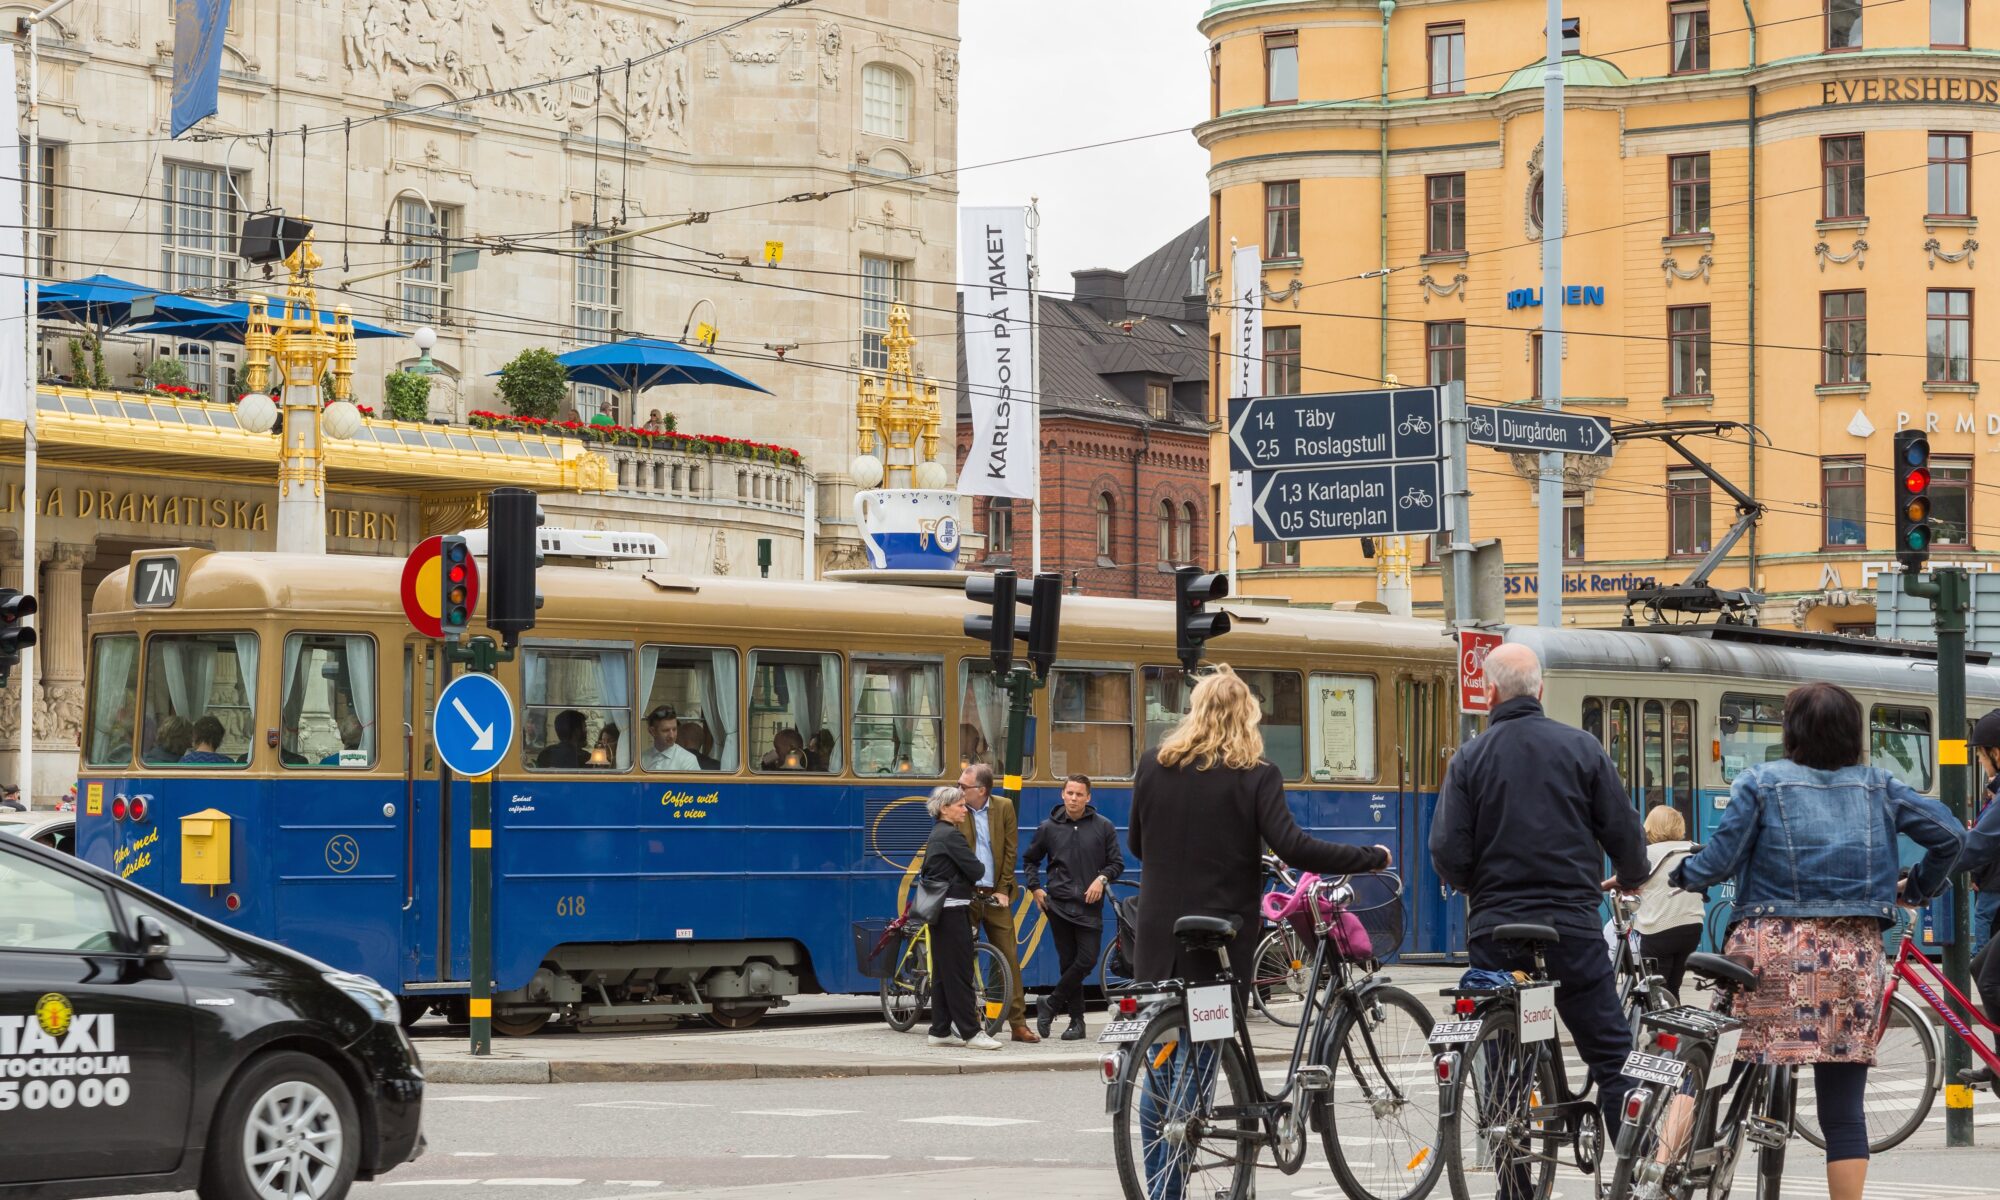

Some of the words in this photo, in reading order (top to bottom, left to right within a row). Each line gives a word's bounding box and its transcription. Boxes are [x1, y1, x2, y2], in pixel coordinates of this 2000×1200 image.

[1821, 77, 1998, 105] EVERSHEDS
[986, 224, 1008, 301] TAKET
[1507, 285, 1604, 310] HOLEN
[986, 306, 1010, 339] PÅ
[987, 347, 1011, 479] KARLSSON
[1255, 411, 1275, 430] 14
[1295, 408, 1336, 431] Täby
[1503, 418, 1567, 443] Djurgården
[1578, 425, 1594, 447] 1,1
[1256, 439, 1280, 460] 2,5
[1295, 433, 1386, 458] Roslagstull
[1279, 483, 1302, 505] 1,3
[1308, 479, 1385, 503] Karlaplan
[78, 489, 268, 531] DRAMATISKA
[325, 508, 398, 541] TERN
[1280, 510, 1303, 532] 0,5
[1309, 506, 1387, 530] Stureplan
[146, 563, 175, 602] 7N
[661, 790, 694, 807] Coffee
[696, 791, 719, 804] with
[673, 810, 681, 818] a
[683, 808, 707, 818] view
[133, 826, 159, 851] med
[556, 895, 586, 917] 618
[676, 930, 692, 938] LYFT
[1192, 1004, 1230, 1023] Scandic
[1523, 1005, 1553, 1024] Scandic
[0, 1013, 115, 1055] TAXI
[1105, 1022, 1123, 1032] BE
[1433, 1023, 1454, 1033] BE
[1628, 1054, 1652, 1067] BE
[1655, 1059, 1682, 1073] 170
